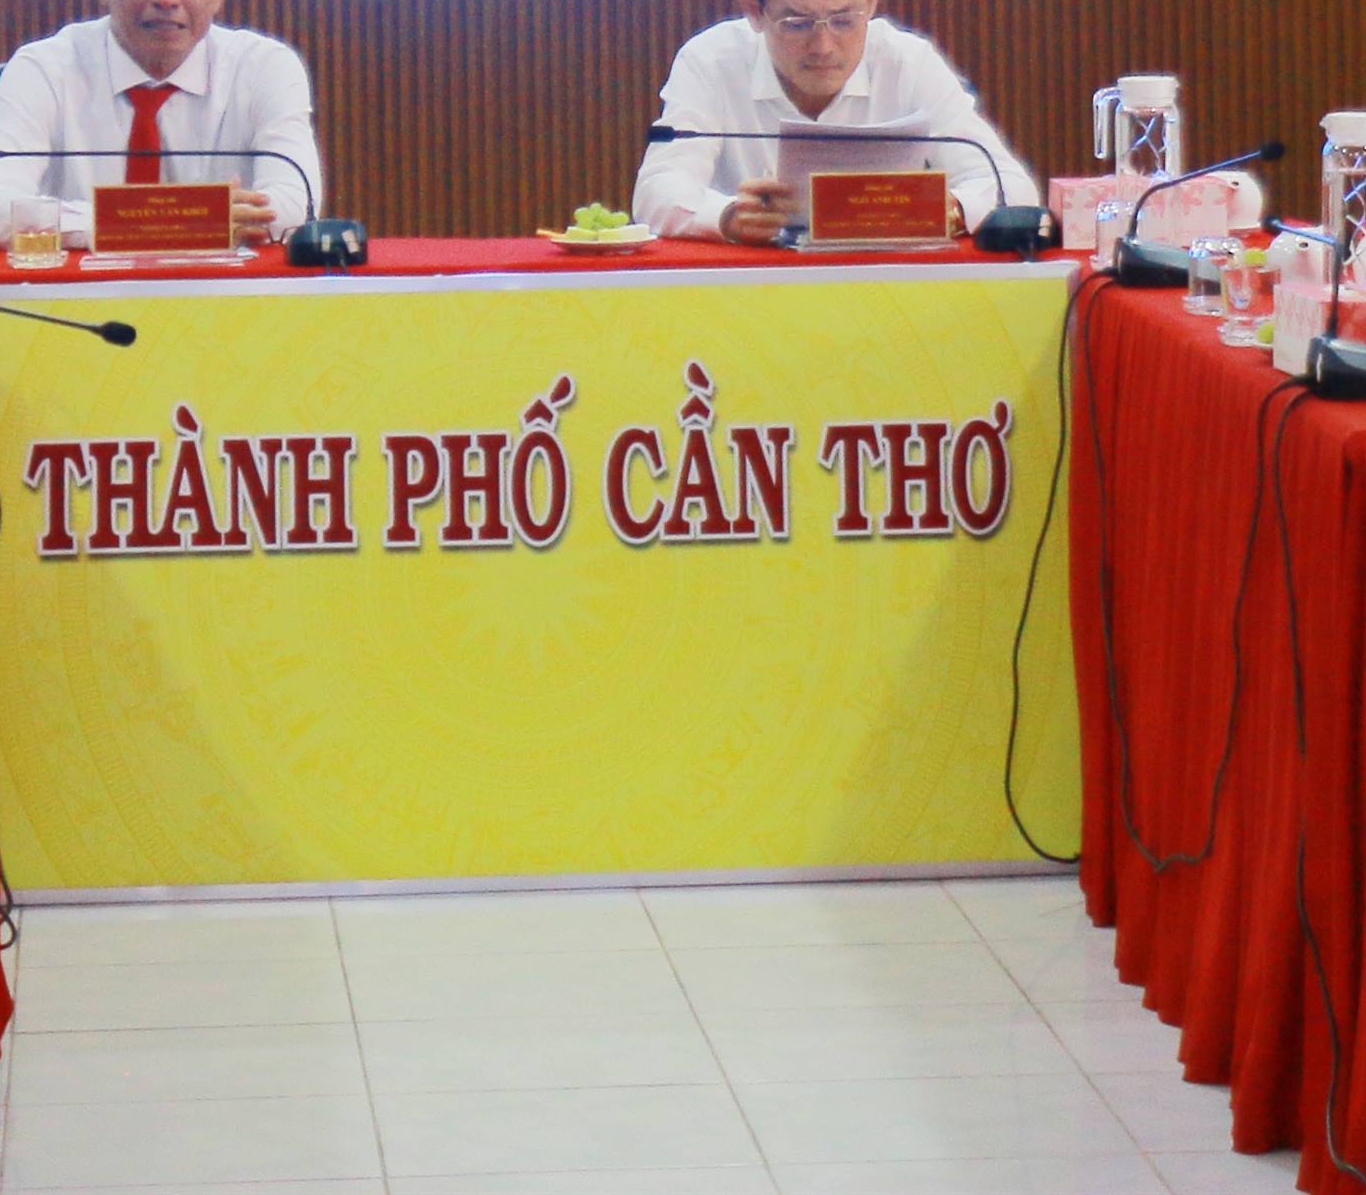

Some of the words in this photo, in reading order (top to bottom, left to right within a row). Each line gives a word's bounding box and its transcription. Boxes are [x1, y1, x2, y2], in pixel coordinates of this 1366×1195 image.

[26, 403, 355, 552] THÀNH
[383, 374, 574, 544] PHỐ
[605, 360, 792, 541] CẦN
[819, 399, 1011, 533] THƠ
